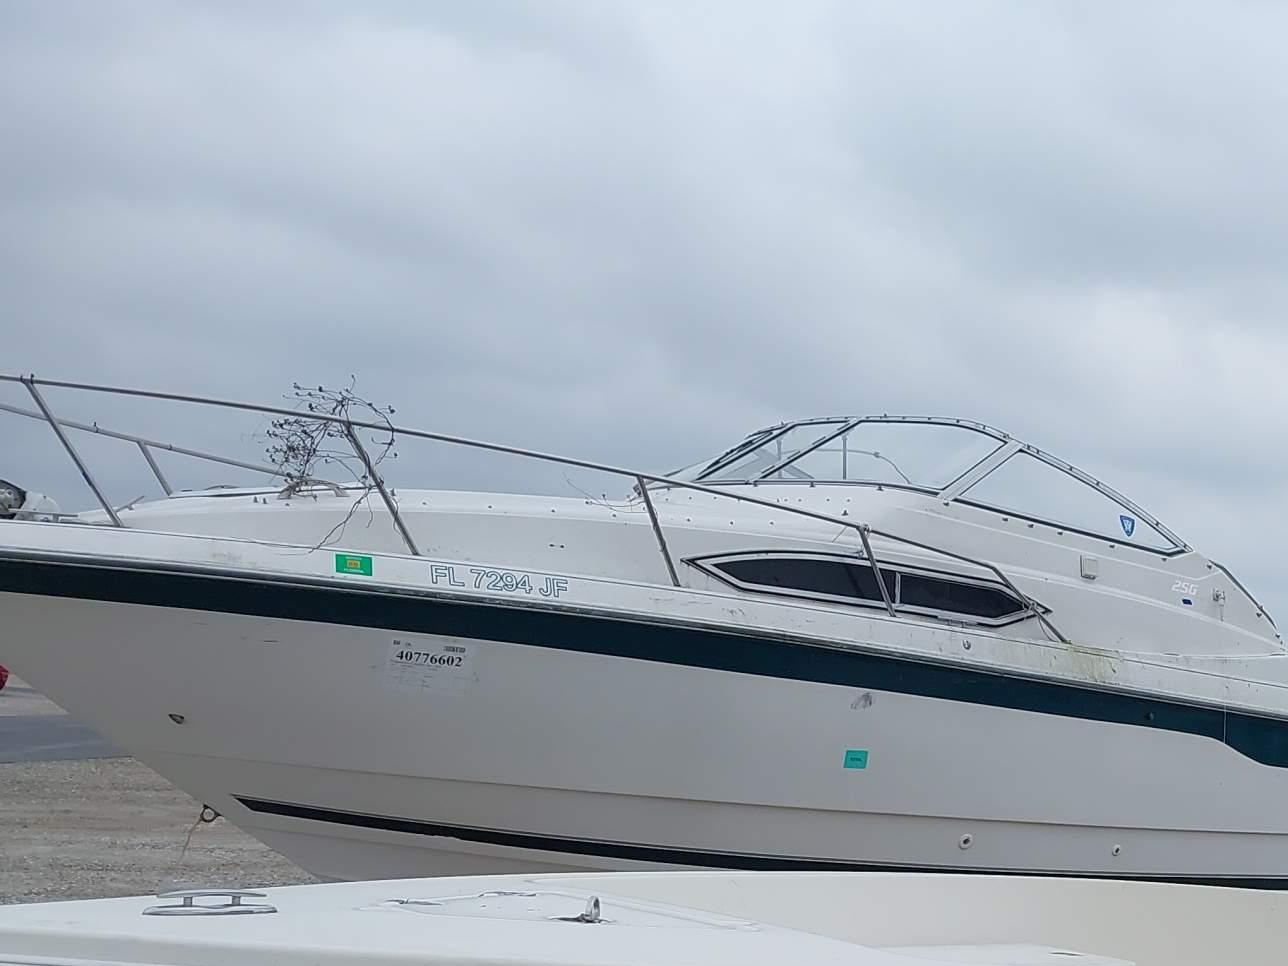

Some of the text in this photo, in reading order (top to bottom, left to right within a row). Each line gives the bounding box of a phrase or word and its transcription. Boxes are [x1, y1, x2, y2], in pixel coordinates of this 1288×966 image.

[430, 565, 568, 598] FL 7294 JF
[396, 650, 463, 667] 40776602
